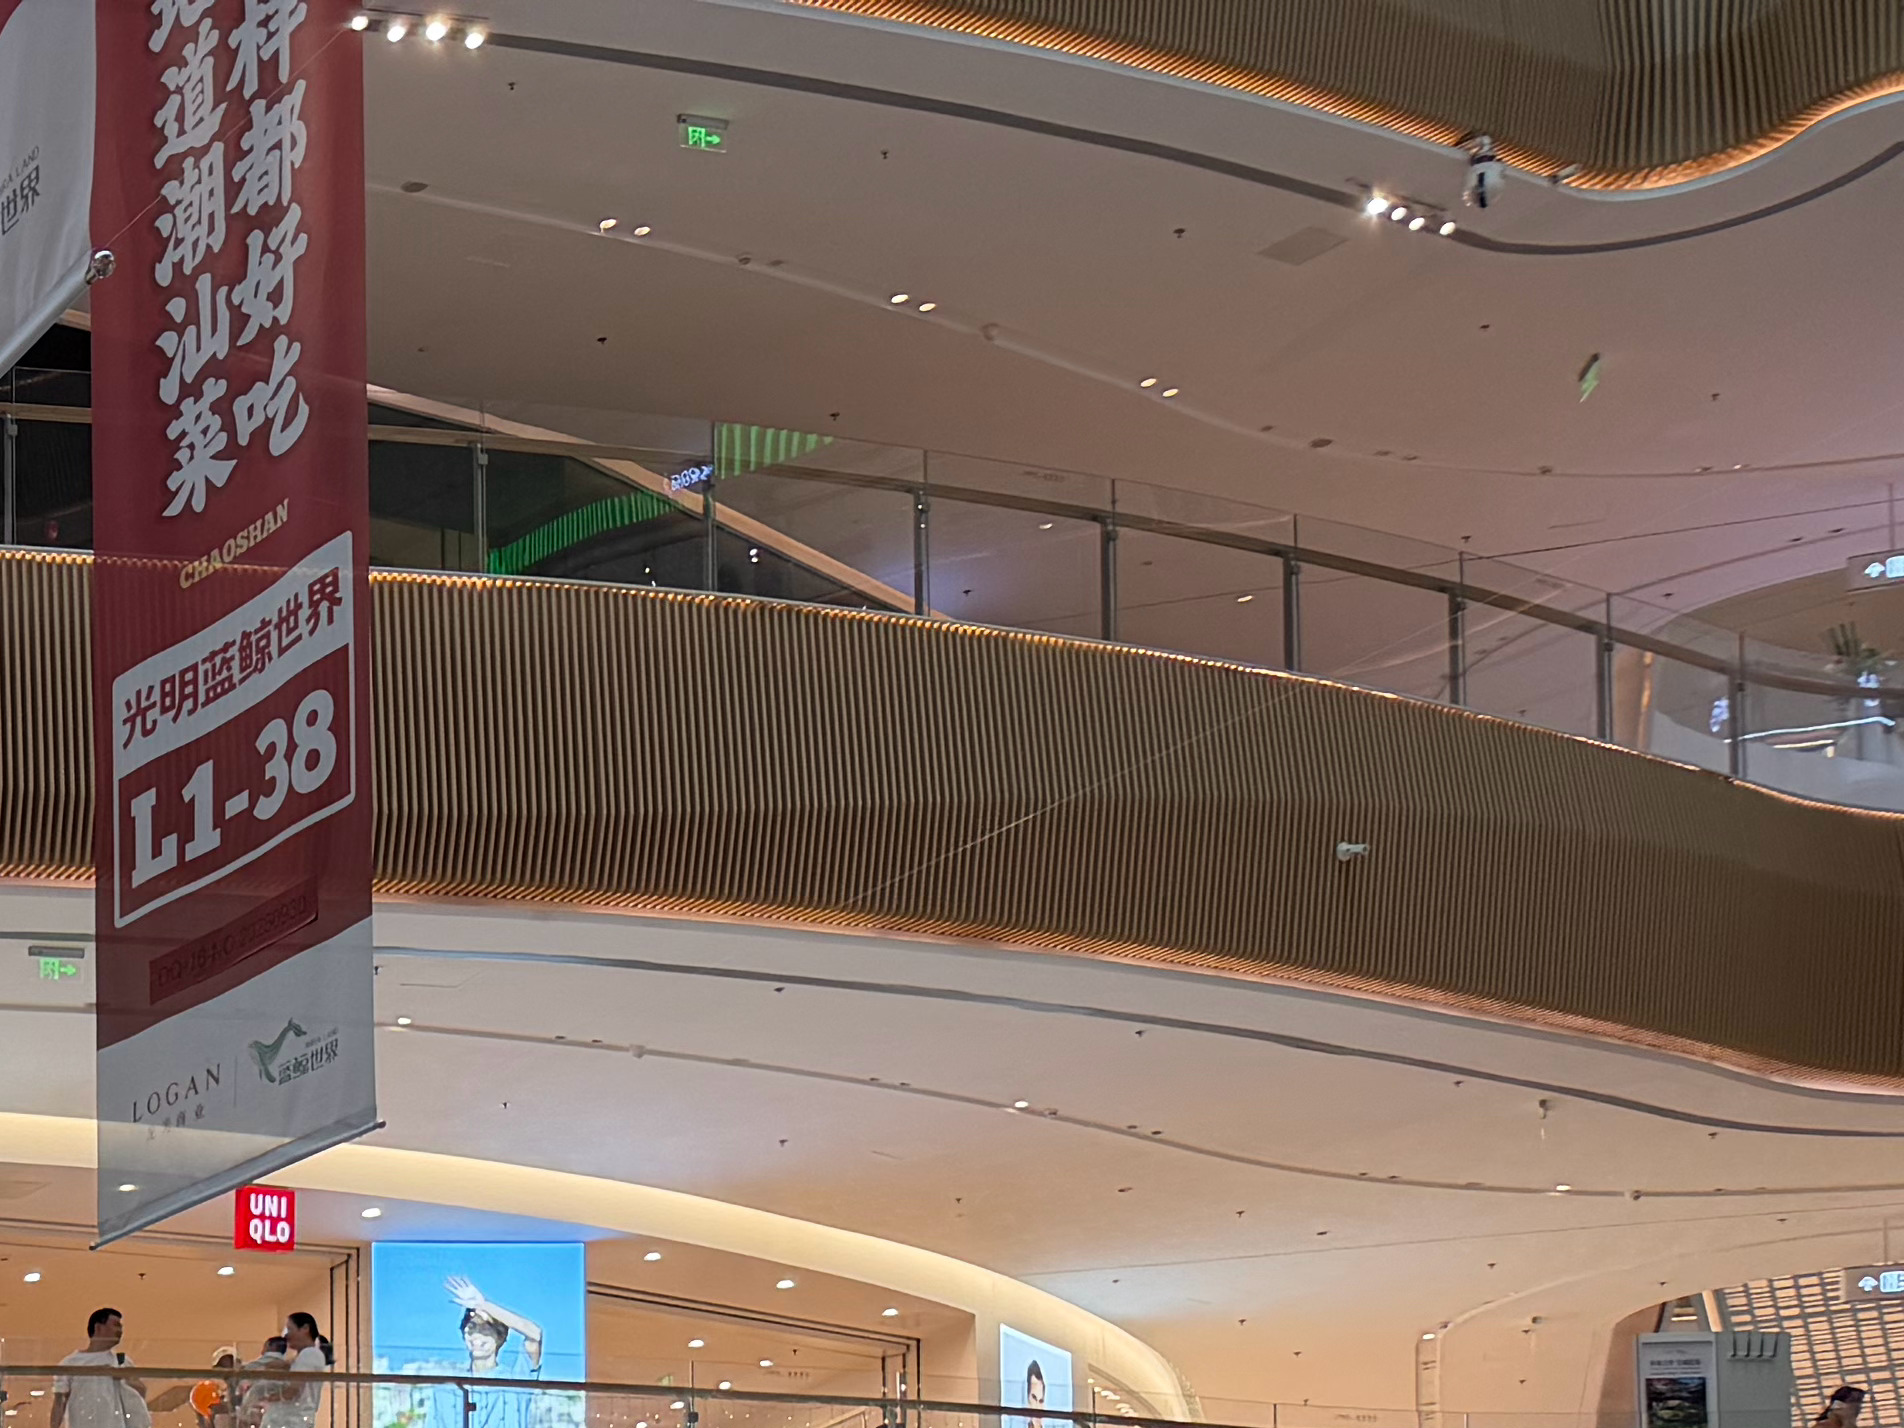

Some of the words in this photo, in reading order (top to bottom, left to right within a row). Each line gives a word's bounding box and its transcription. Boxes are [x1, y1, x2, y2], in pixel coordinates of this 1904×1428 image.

[179, 498, 290, 590] CHAOSHAN
[122, 566, 343, 749] 光明蓝鲸世界
[131, 687, 338, 889] L1-38
[132, 1063, 221, 1123] LOGAN
[249, 1192, 288, 1216] UNI
[249, 1219, 291, 1244] QLO
